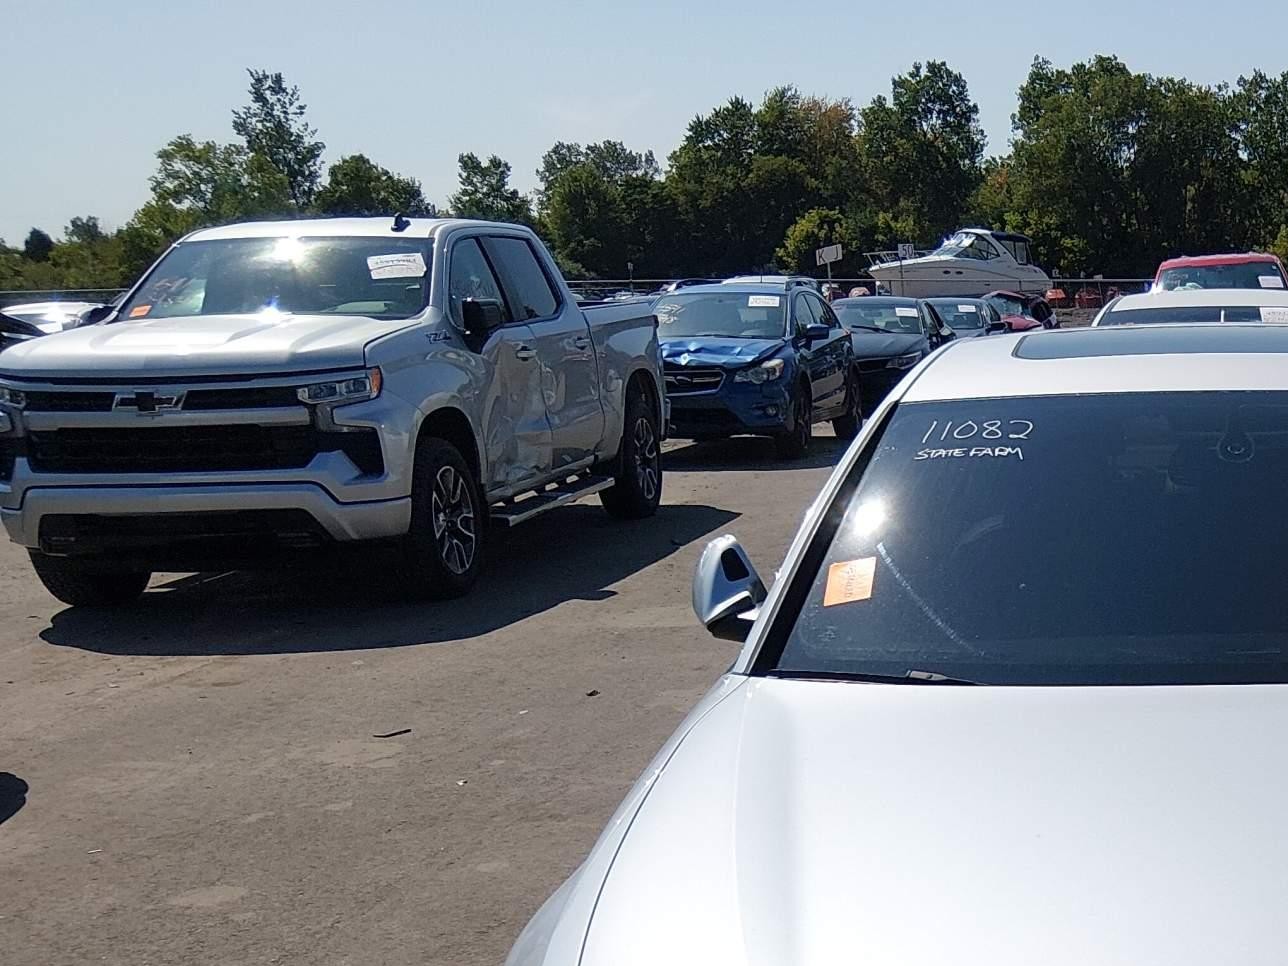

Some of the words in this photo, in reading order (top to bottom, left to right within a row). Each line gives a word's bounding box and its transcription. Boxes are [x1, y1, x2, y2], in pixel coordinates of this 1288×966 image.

[818, 249, 826, 264] K
[901, 244, 914, 257] 50
[921, 420, 1034, 443] 11082
[914, 447, 968, 460] STATE
[969, 446, 1024, 460] FARM
